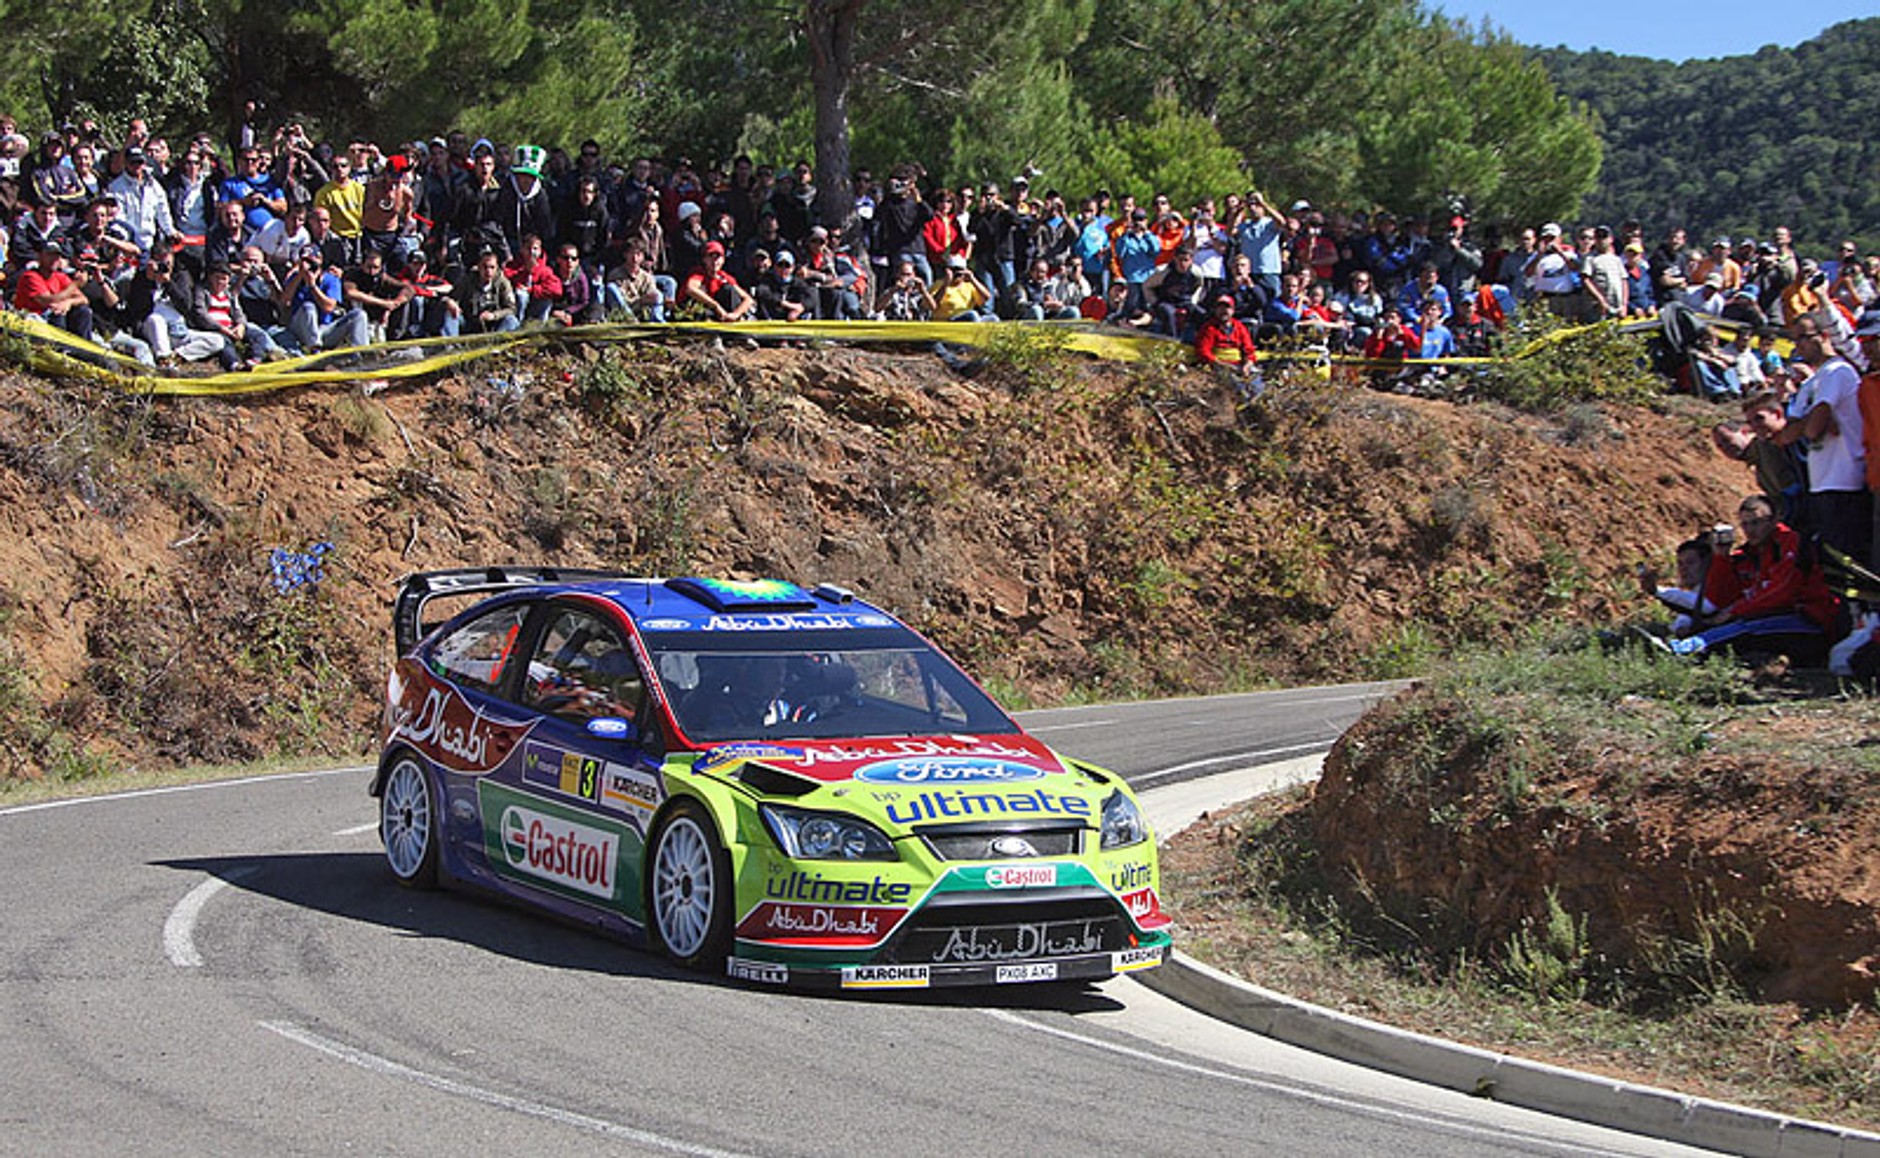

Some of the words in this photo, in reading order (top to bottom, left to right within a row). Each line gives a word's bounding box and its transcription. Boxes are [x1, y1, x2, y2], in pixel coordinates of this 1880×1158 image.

[582, 760, 597, 798] 3
[896, 759, 1015, 782] Ford
[886, 789, 1091, 823] ultimate
[528, 820, 609, 889] Castrol
[766, 871, 912, 903] ultimate
[1004, 869, 1051, 884] Castrol
